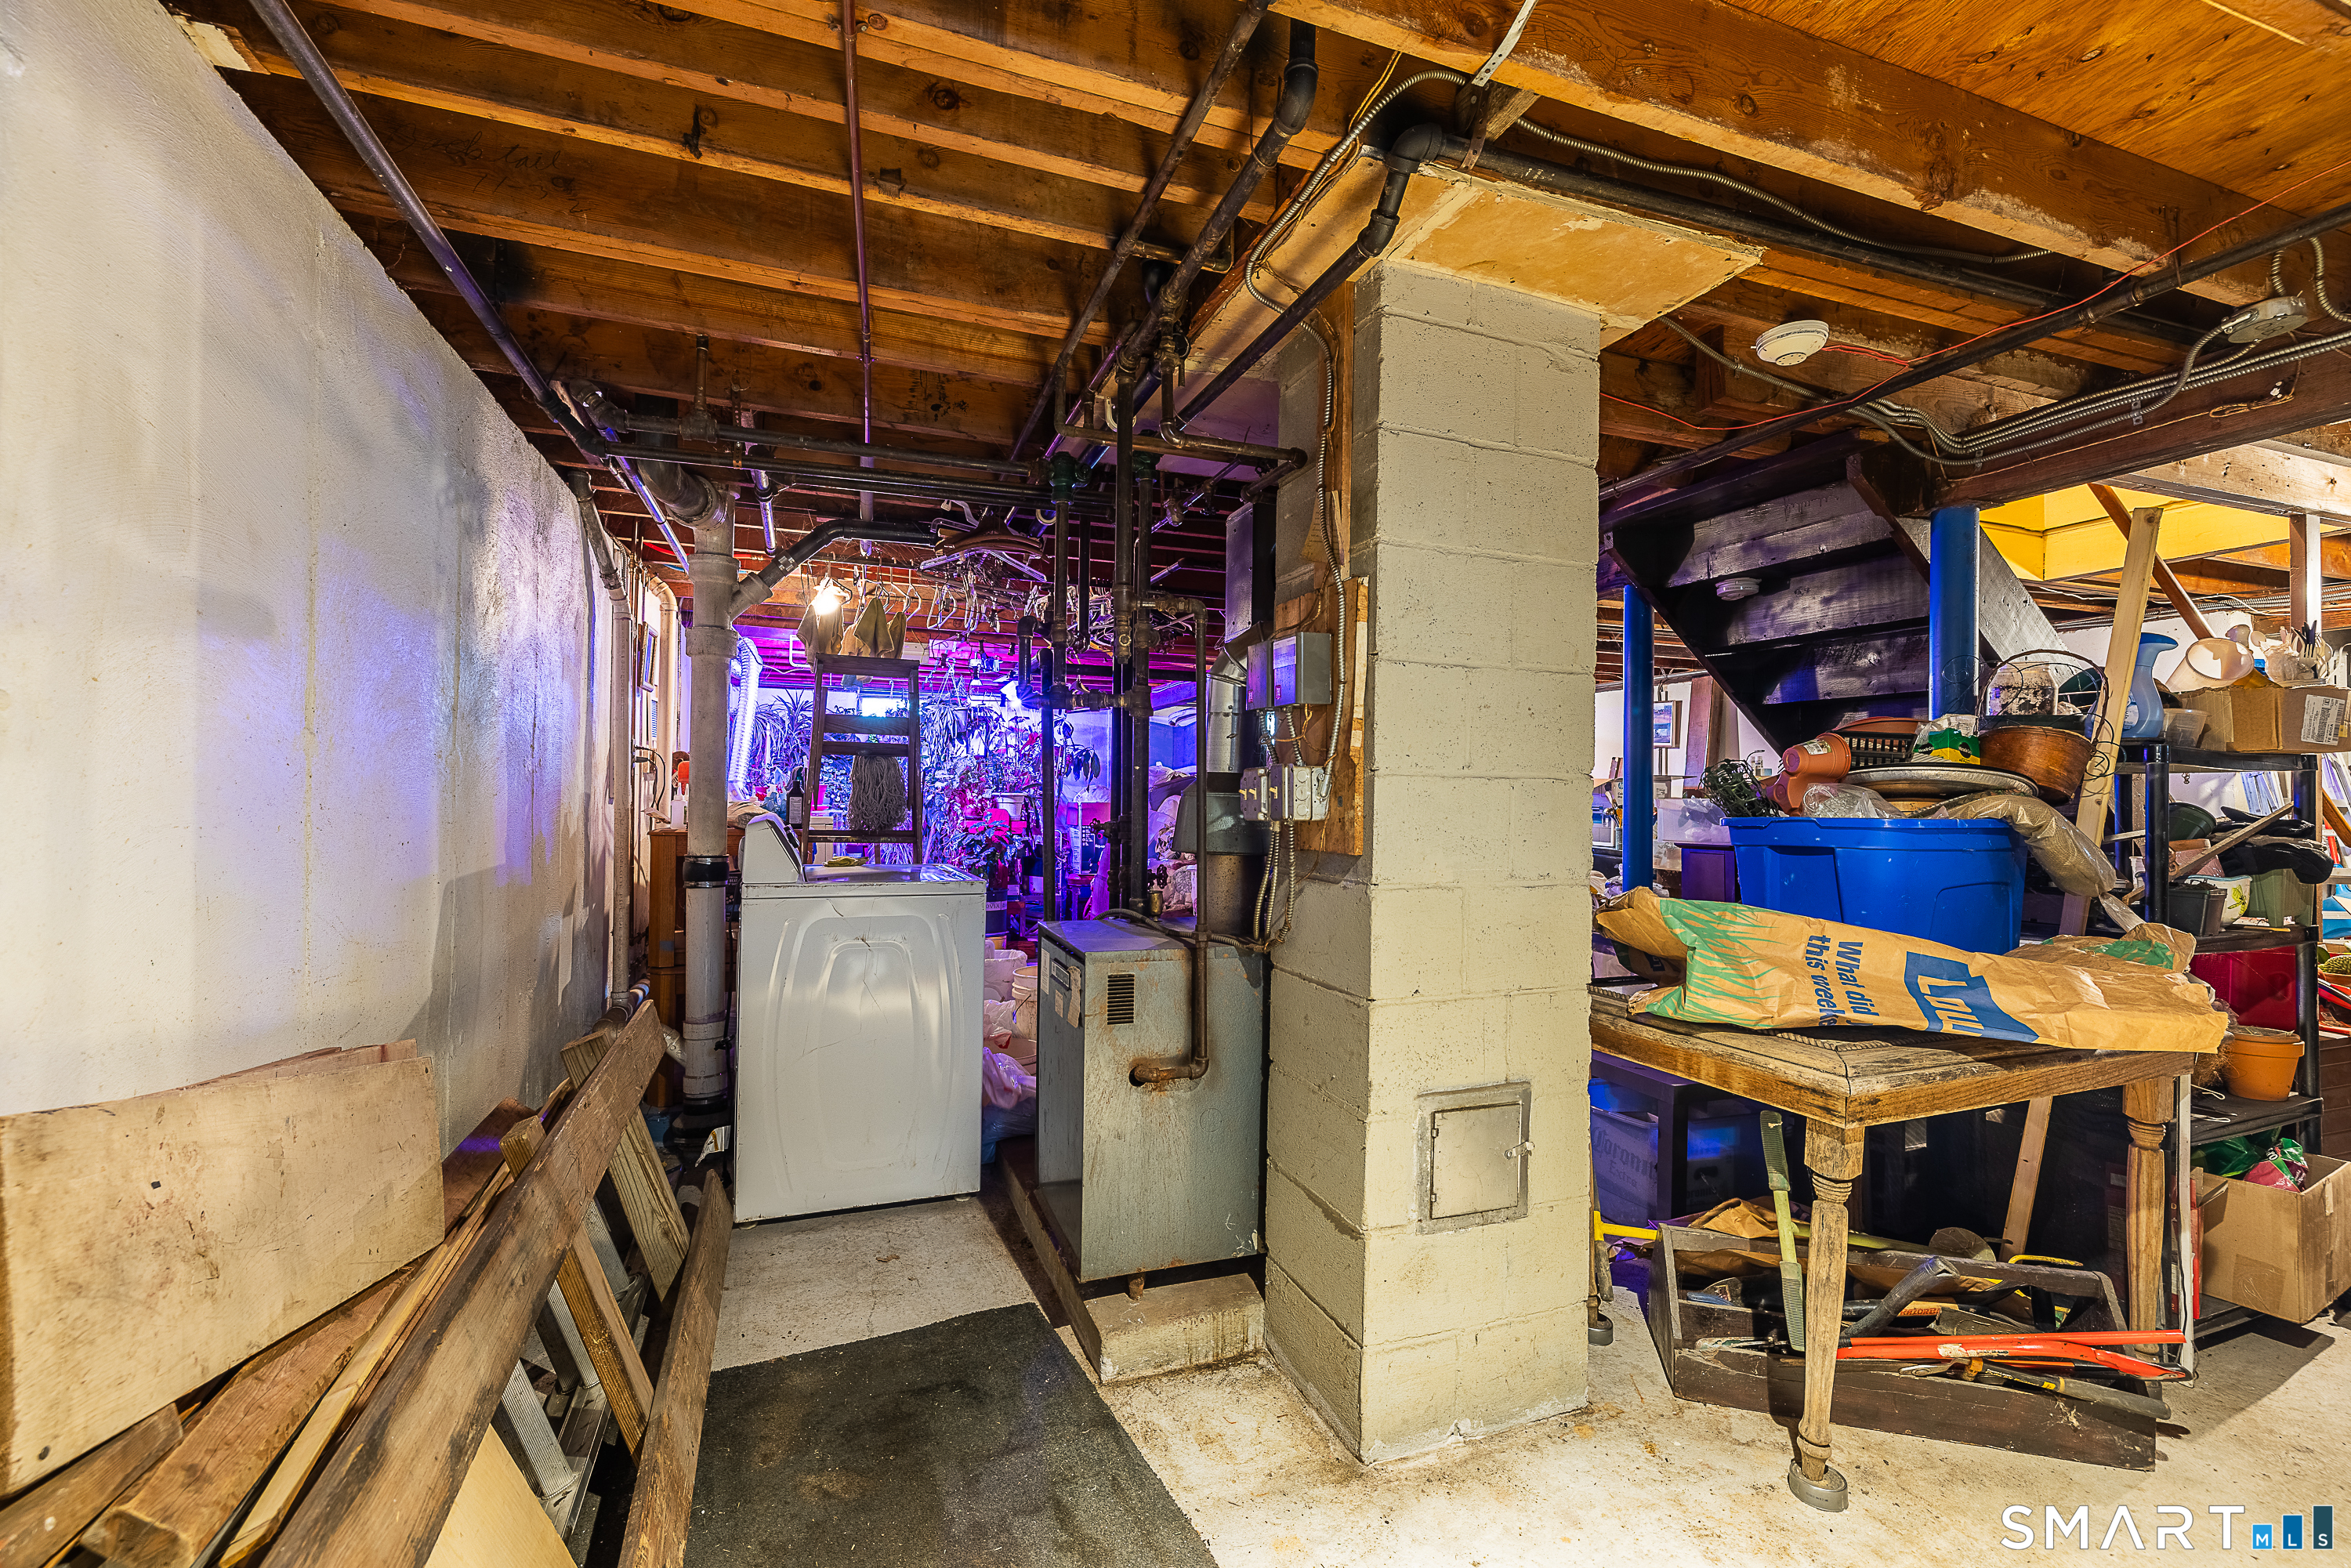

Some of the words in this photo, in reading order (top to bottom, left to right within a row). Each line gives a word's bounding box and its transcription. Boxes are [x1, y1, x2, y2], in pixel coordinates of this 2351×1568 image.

[1805, 935, 1831, 971] this
[1835, 941, 1865, 988] What
[1845, 990, 1880, 1016] did
[1609, 1158, 1638, 1189] Extra
